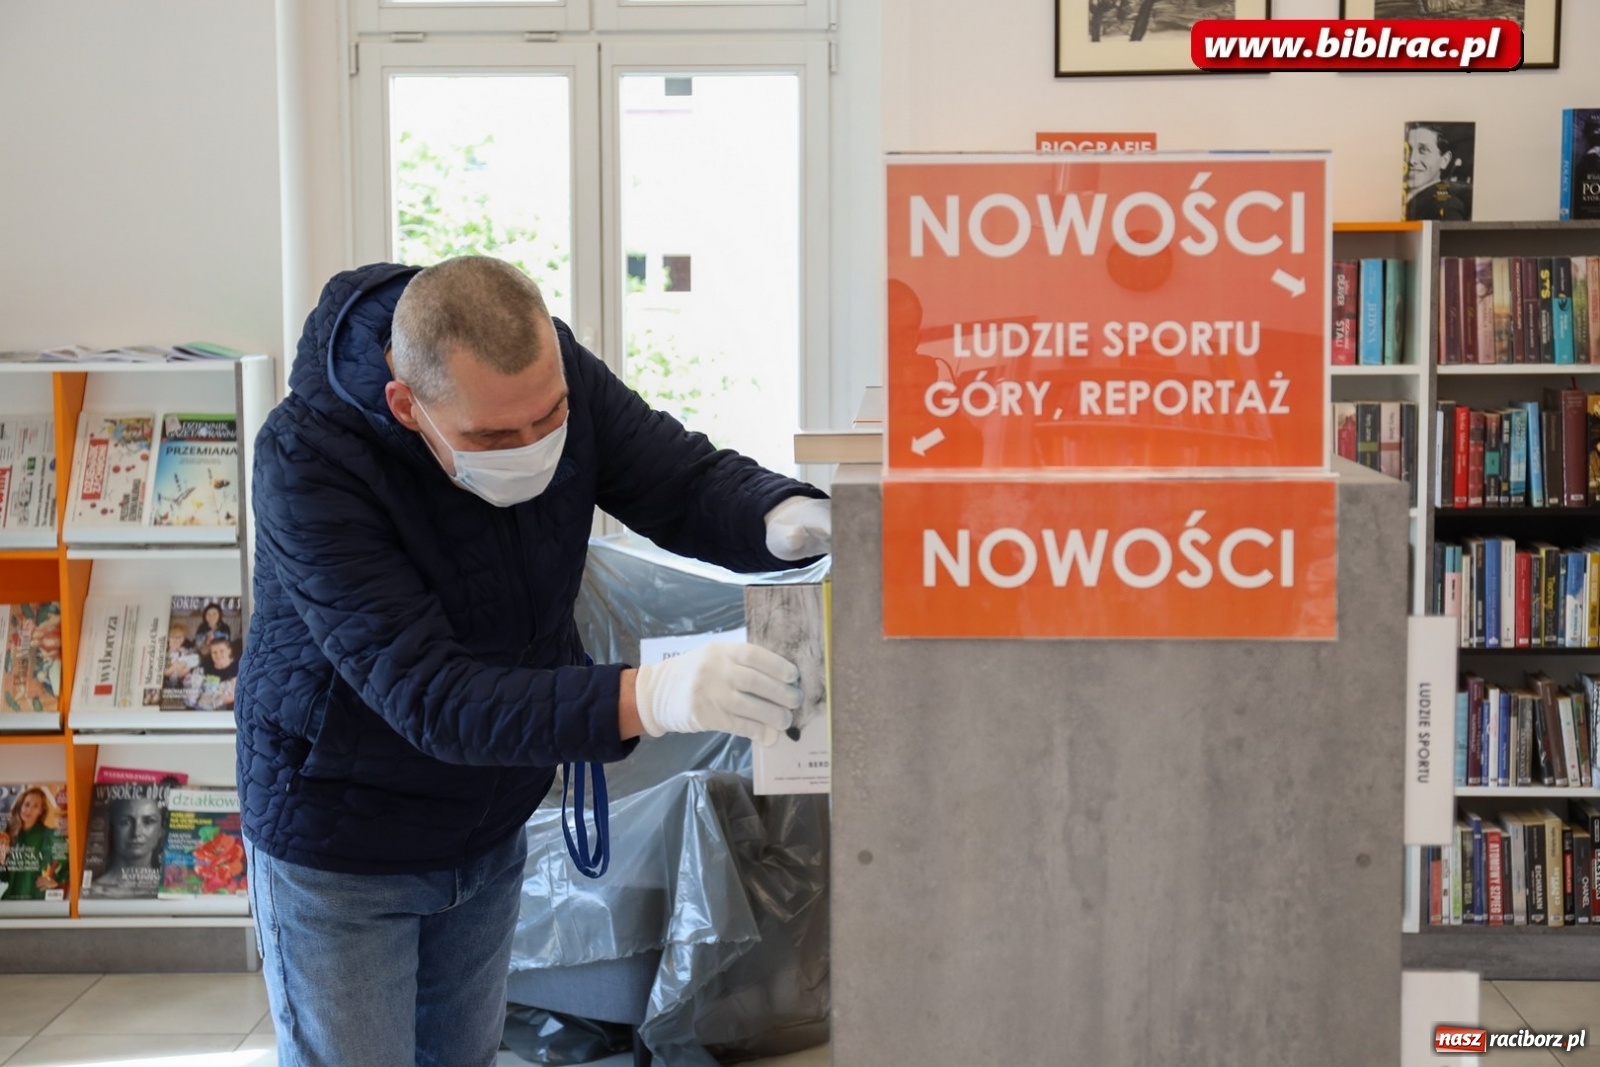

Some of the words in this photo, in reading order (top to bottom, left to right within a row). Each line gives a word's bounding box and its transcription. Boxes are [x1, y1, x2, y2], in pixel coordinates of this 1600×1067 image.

[1041, 140, 1152, 154] BIOGRAFIE
[909, 171, 1305, 258] NOWOŚCI
[1336, 274, 1345, 306] DEAVER
[953, 322, 1089, 358] LUDZIE
[1102, 321, 1261, 357] SPORTU
[924, 371, 1063, 420] GÓRY,
[1079, 371, 1290, 416] REPORTAŻ
[166, 446, 237, 455] PRZEMIANA
[923, 510, 1295, 589] NOWOŚCI
[1547, 576, 1556, 610] Tischner
[1418, 683, 1431, 727] LUDZIE
[1418, 730, 1430, 784] SPORTU
[96, 782, 143, 803] wysokie
[1489, 843, 1500, 884] ATOMOWY
[1490, 886, 1500, 913] SZPIEG
[1534, 865, 1544, 910] EICHMANN
